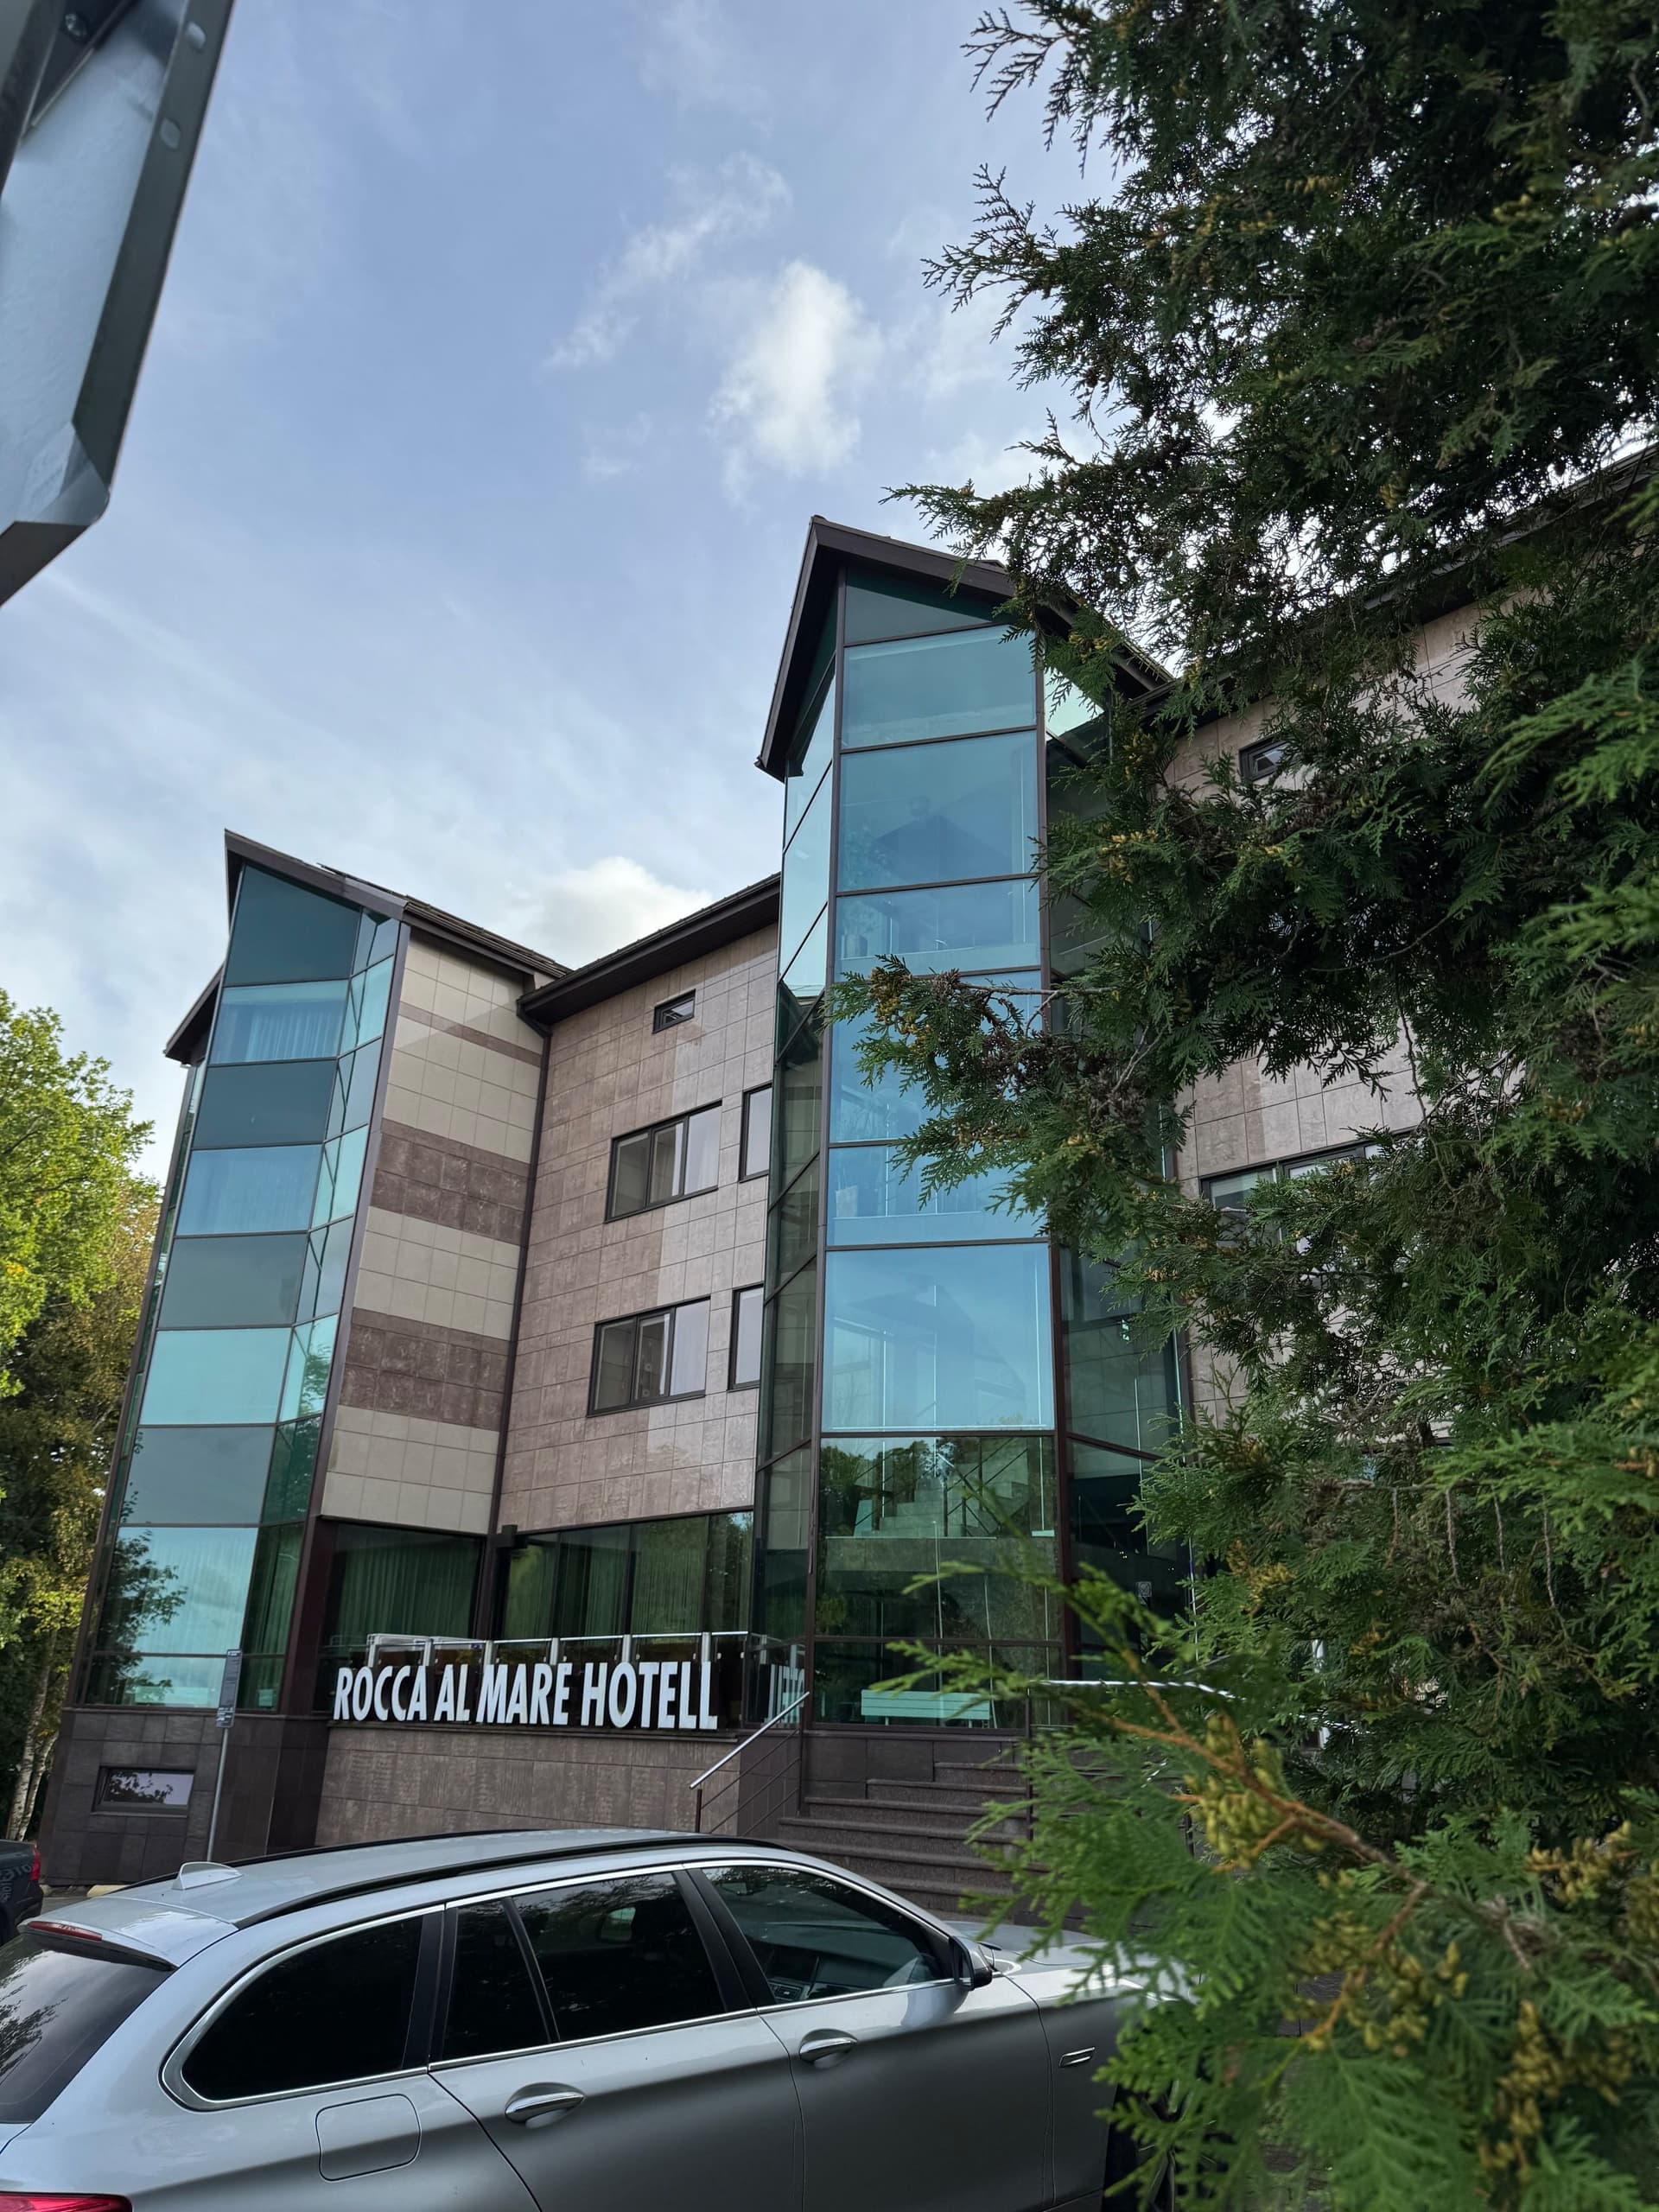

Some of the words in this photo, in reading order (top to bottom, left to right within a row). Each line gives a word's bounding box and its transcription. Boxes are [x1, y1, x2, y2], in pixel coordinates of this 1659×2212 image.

[334, 1665, 427, 1721] ROCCA
[434, 1664, 470, 1721] AL
[475, 1662, 573, 1725] MARE
[581, 1662, 718, 1729] HOTELL
